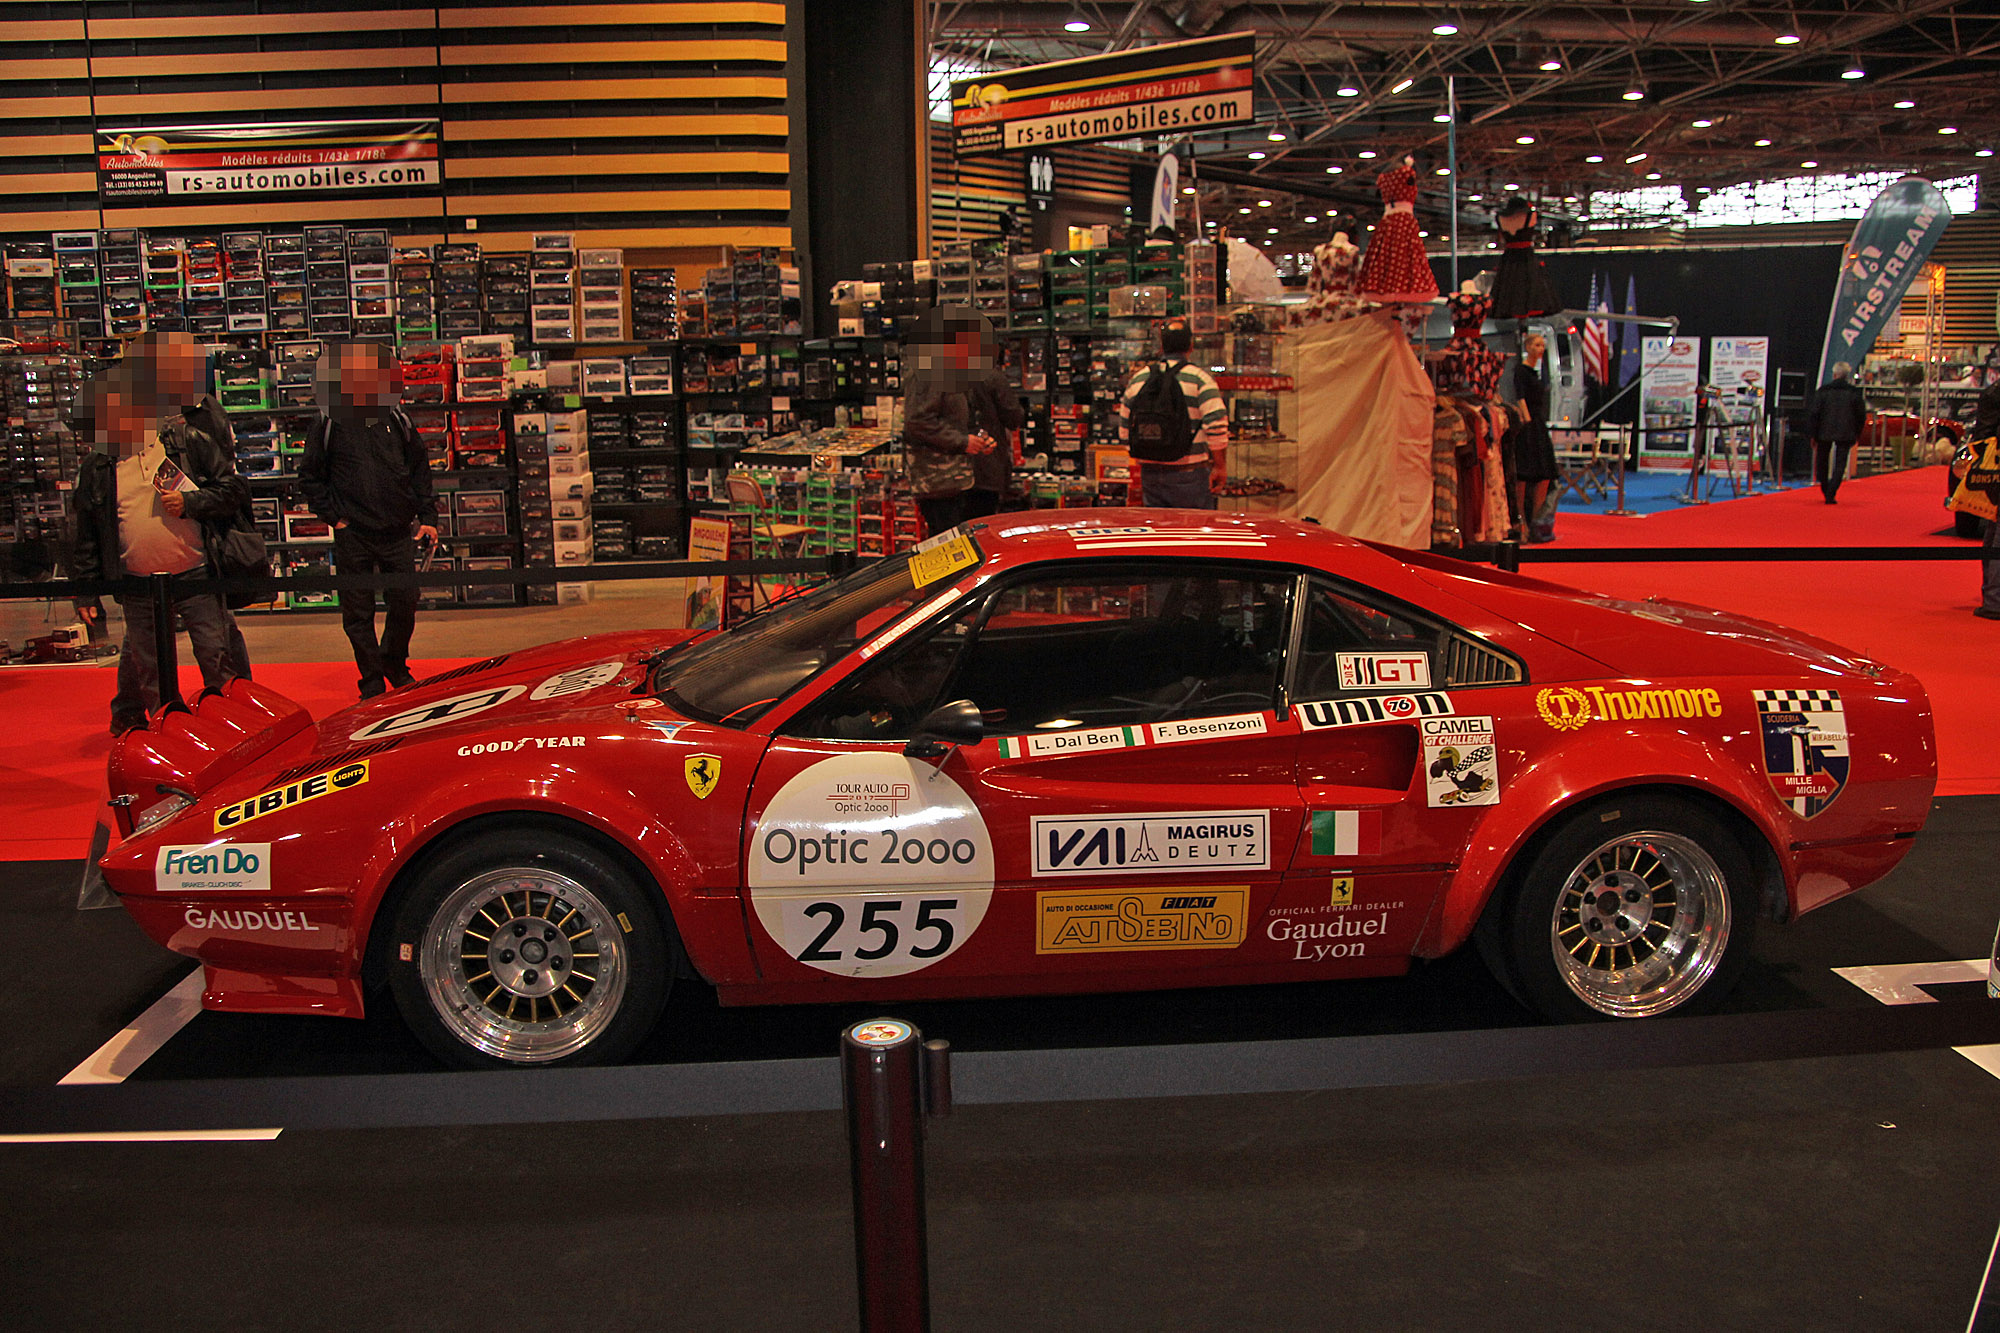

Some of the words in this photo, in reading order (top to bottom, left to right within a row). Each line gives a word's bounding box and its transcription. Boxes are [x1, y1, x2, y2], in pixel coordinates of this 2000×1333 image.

[1050, 96, 1090, 112] Modèles
[1093, 91, 1130, 106] réduits
[1017, 101, 1238, 143] rs-automobiles.com
[106, 157, 164, 168] Automobiles
[222, 155, 268, 166] Modèles
[272, 153, 312, 164] réduits
[319, 151, 349, 163] 1/43è
[355, 149, 386, 161] 1/18è
[182, 167, 425, 191] rs-automobiles.com
[1841, 205, 1938, 347] AIRSTREAM
[1376, 659, 1423, 682] GT
[1584, 686, 1722, 721] Truxmore
[1158, 726, 1172, 738] F.
[1177, 717, 1262, 736] Besenzoni
[1424, 719, 1491, 734] CAMEL
[1766, 715, 1800, 724] SCUDERIA
[457, 740, 514, 757] GOOD
[535, 735, 586, 750] YEAR
[1034, 738, 1050, 750] L.
[1055, 735, 1082, 749] Dal
[1088, 732, 1119, 746] Ben
[1425, 736, 1438, 746] GT
[1438, 734, 1492, 746] CHALLENGE
[1811, 732, 1848, 742] MIRABELLA
[333, 766, 365, 784] LIGHTS
[1785, 777, 1812, 785] MILLE
[836, 783, 860, 793] TOUR
[863, 783, 889, 793] AUTO
[1796, 786, 1827, 794] MIGLIA
[217, 773, 328, 828] CIBIE
[834, 802, 861, 814] Optic
[1167, 824, 1255, 840] MAGIRUS
[764, 829, 868, 875] Optic
[165, 850, 218, 875] Fren
[223, 848, 260, 874] Do
[1046, 905, 1064, 913] AUTO
[1075, 903, 1114, 911] OCCASIONE
[1162, 897, 1216, 909] FIAT
[1269, 907, 1316, 916] OFFICIAL
[1320, 904, 1362, 913] FERRARI
[1366, 901, 1404, 911] DEALER
[184, 908, 319, 931] GAUDUEL
[1266, 912, 1388, 941] Gauduel
[796, 899, 958, 962] 255
[1293, 940, 1366, 962] Lyon
